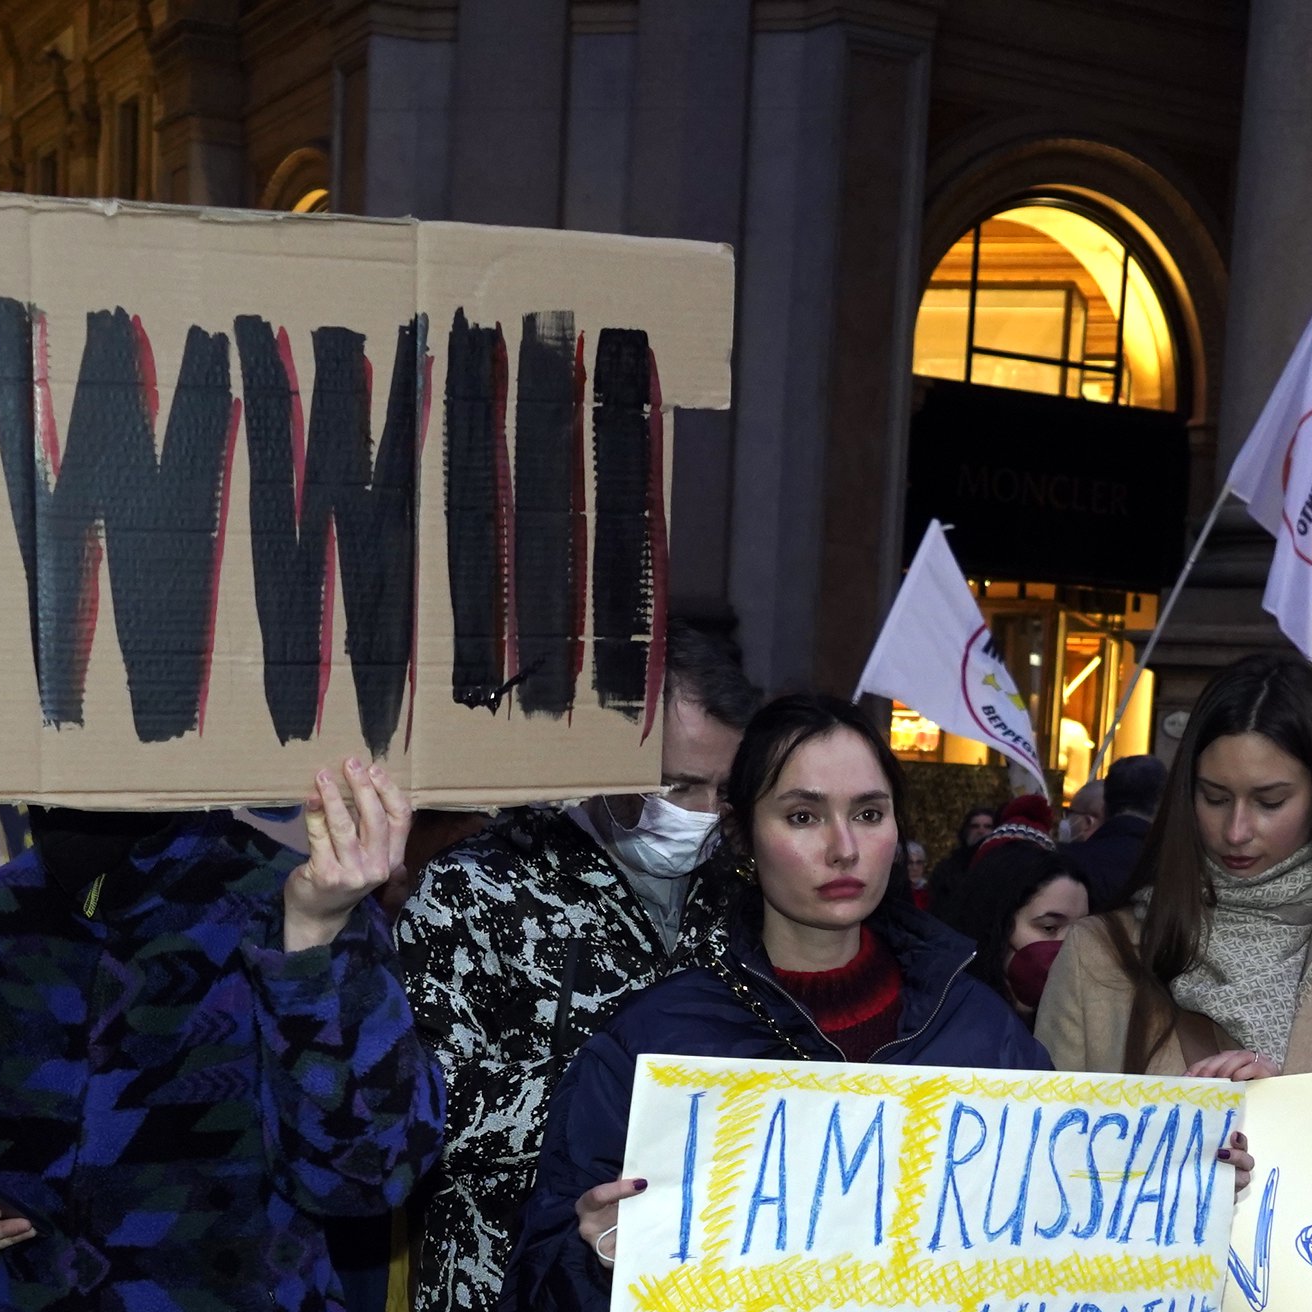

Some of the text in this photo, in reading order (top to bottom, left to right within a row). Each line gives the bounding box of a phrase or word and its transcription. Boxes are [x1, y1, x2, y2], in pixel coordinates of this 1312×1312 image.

[956, 463, 1130, 517] MONCLER
[982, 705, 1037, 759] BEPPEG
[670, 1091, 1236, 1264] I AM RUSSIAN
